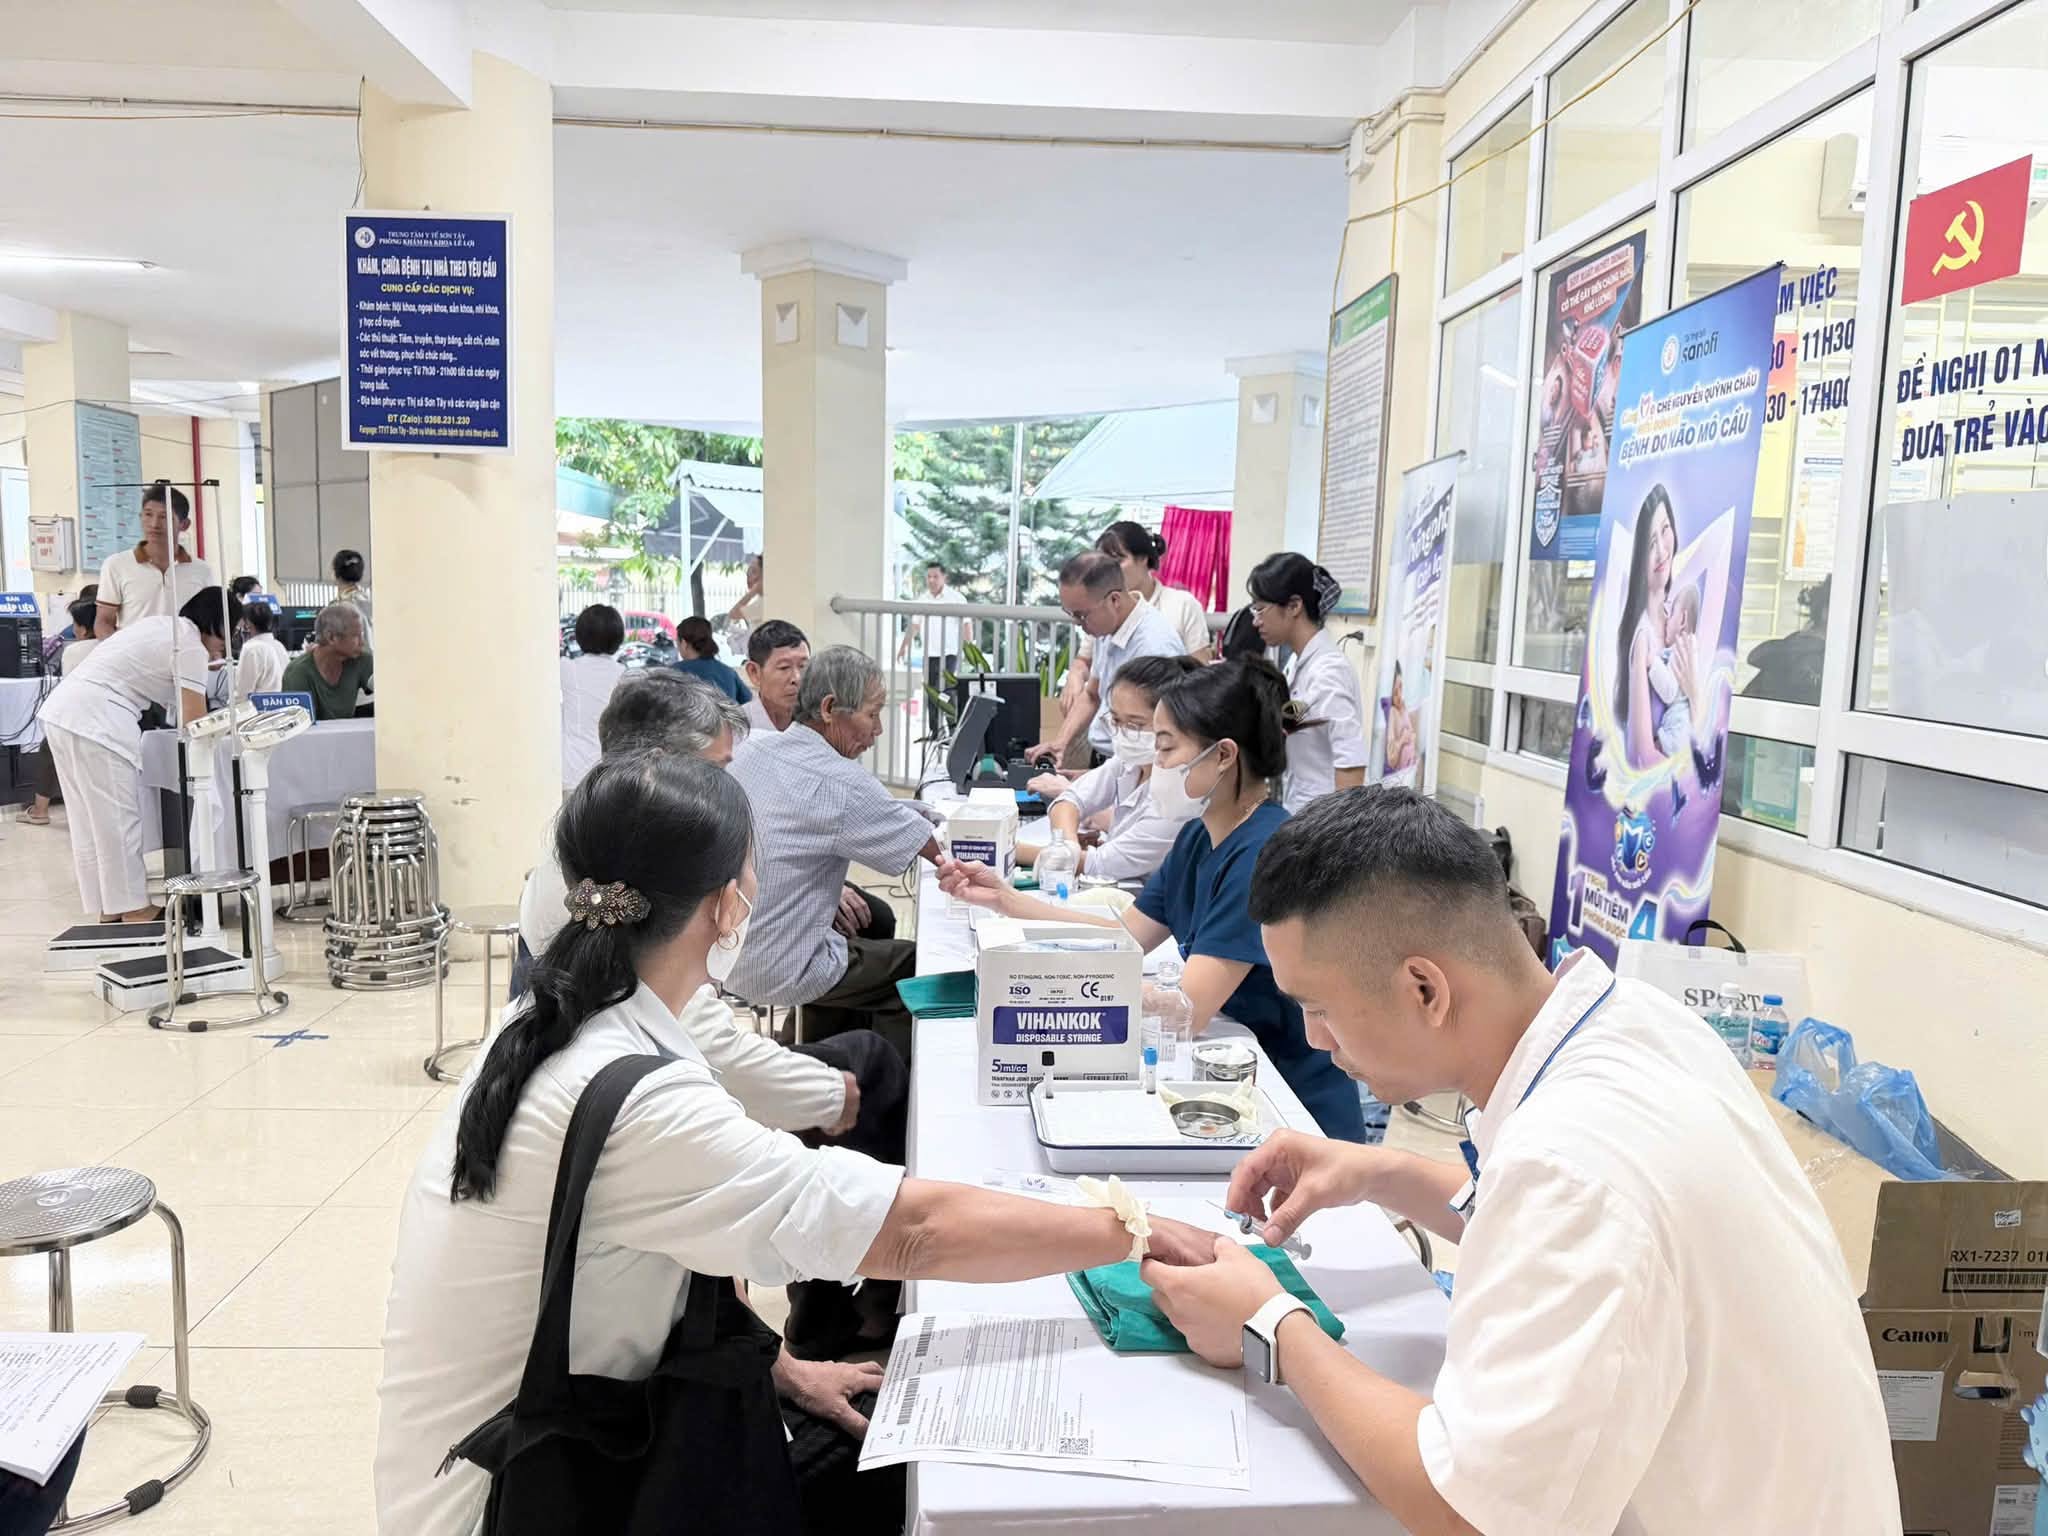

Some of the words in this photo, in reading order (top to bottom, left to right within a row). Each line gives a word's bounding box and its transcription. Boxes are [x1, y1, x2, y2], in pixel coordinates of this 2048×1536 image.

[401, 255, 420, 279] BỆNH
[421, 259, 433, 280] TẠI
[449, 259, 467, 278] THEO
[380, 283, 404, 293] CUNG
[422, 282, 440, 294] CÁC
[441, 285, 461, 296] DỊCH
[1776, 281, 1794, 315] M
[1799, 263, 1838, 309] VIỆC
[1680, 330, 1720, 364] sanofi
[1802, 318, 1856, 362] 11H30
[1896, 351, 1927, 404] ĐỀ
[1930, 350, 1987, 396] NGHỊ
[1993, 342, 2023, 384] 01
[1762, 391, 1786, 424] 30
[1901, 420, 1945, 462] ĐƯA
[1953, 399, 1996, 455] TRẺ
[1008, 986, 1031, 995] ISO
[1080, 982, 1100, 998] CE
[1016, 1012, 1102, 1030] VIHANKOK
[1016, 1033, 1066, 1043] DISPOSABLE
[1067, 1033, 1102, 1043] SYRINGE
[992, 1059, 1001, 1072] 5
[1003, 1064, 1027, 1072] ml/cc
[1950, 1250, 2020, 1262] RX1-7237
[1882, 1328, 1950, 1343] Canon
